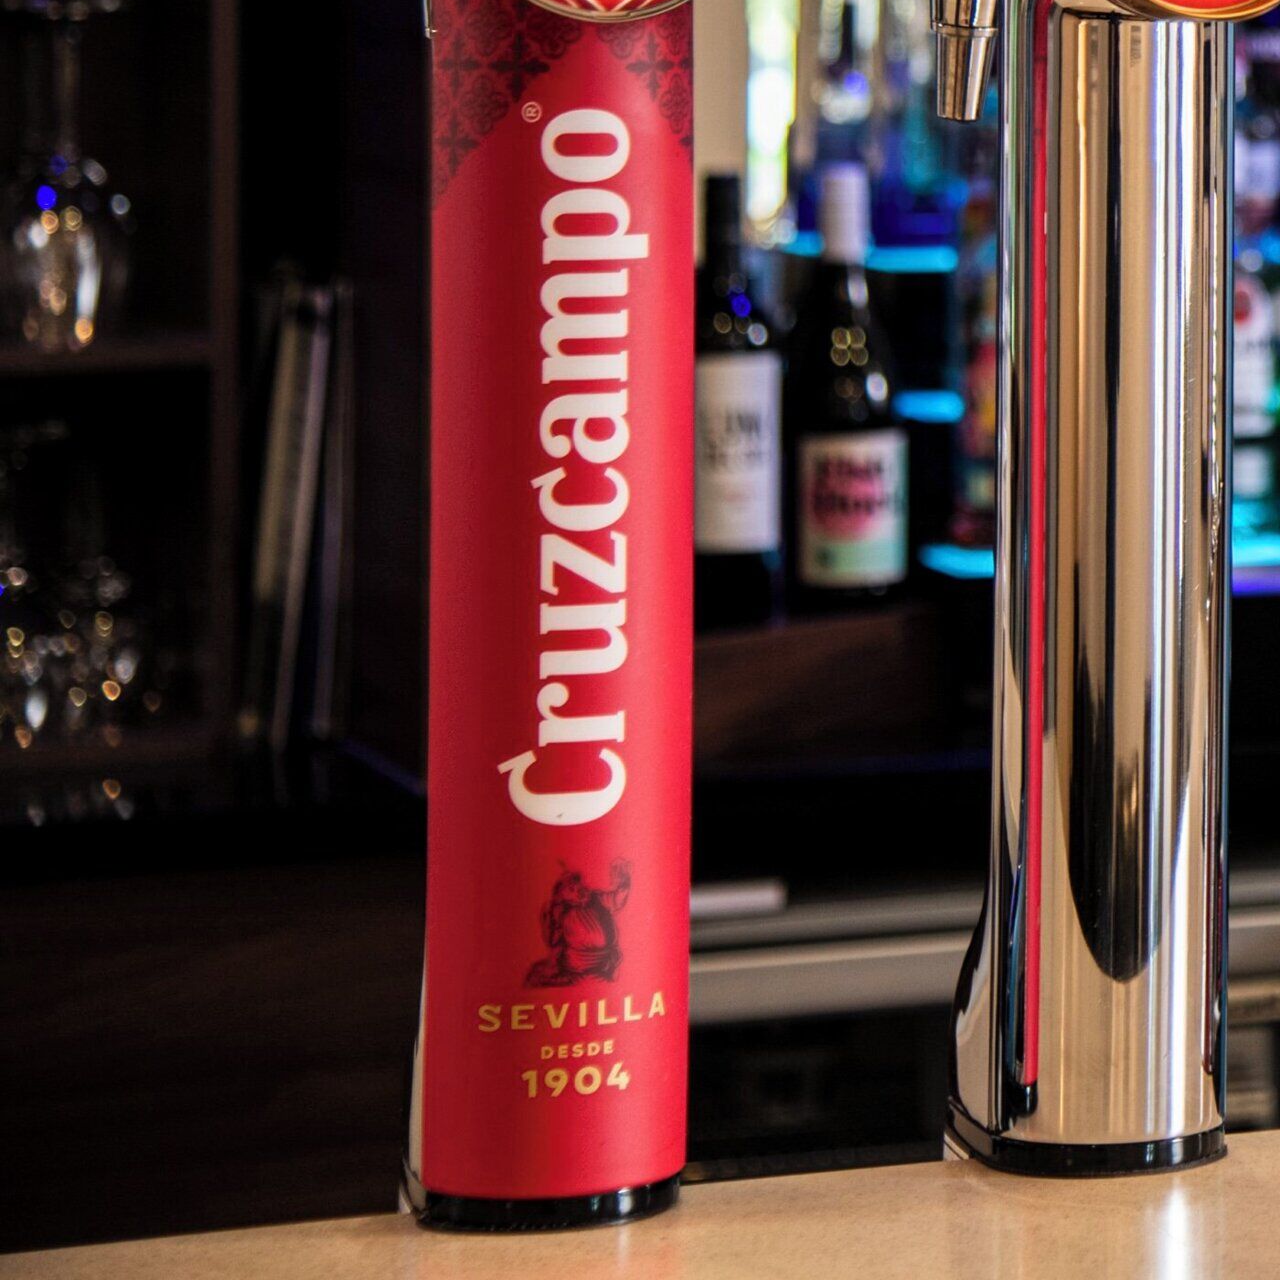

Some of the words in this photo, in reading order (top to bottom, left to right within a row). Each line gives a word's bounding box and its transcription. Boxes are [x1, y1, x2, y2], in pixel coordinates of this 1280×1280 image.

[497, 107, 649, 826] Cruzcampo
[478, 991, 666, 1033] SEVILLA
[541, 1039, 616, 1060] DESDE
[521, 1060, 631, 1099] 1904
